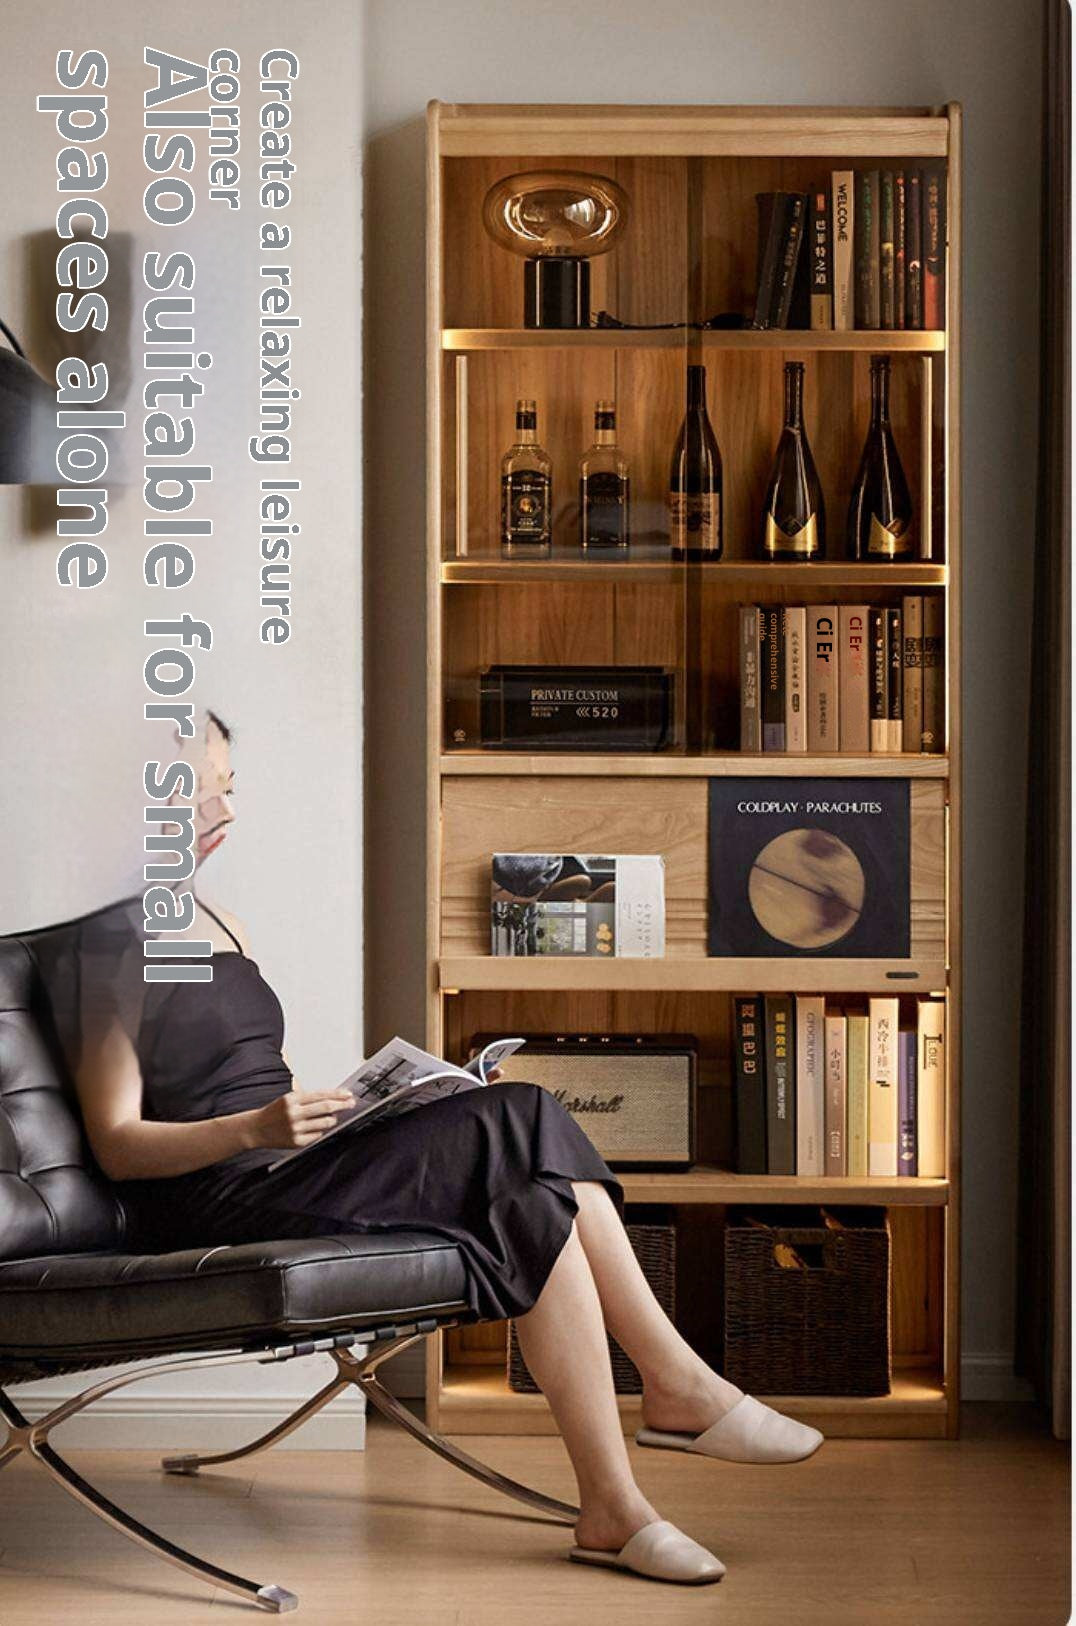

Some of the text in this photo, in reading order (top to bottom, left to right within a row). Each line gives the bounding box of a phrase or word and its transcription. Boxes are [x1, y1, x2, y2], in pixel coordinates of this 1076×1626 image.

[837, 183, 848, 242] WELCOME
[769, 613, 781, 690] comprehensive
[816, 617, 833, 662] Ci Er
[849, 616, 863, 652] Ci Er
[531, 689, 619, 701] PRIVATE CUSTOM
[592, 706, 619, 718] 520
[737, 801, 882, 813] COLDPLAY PARACHUTES
